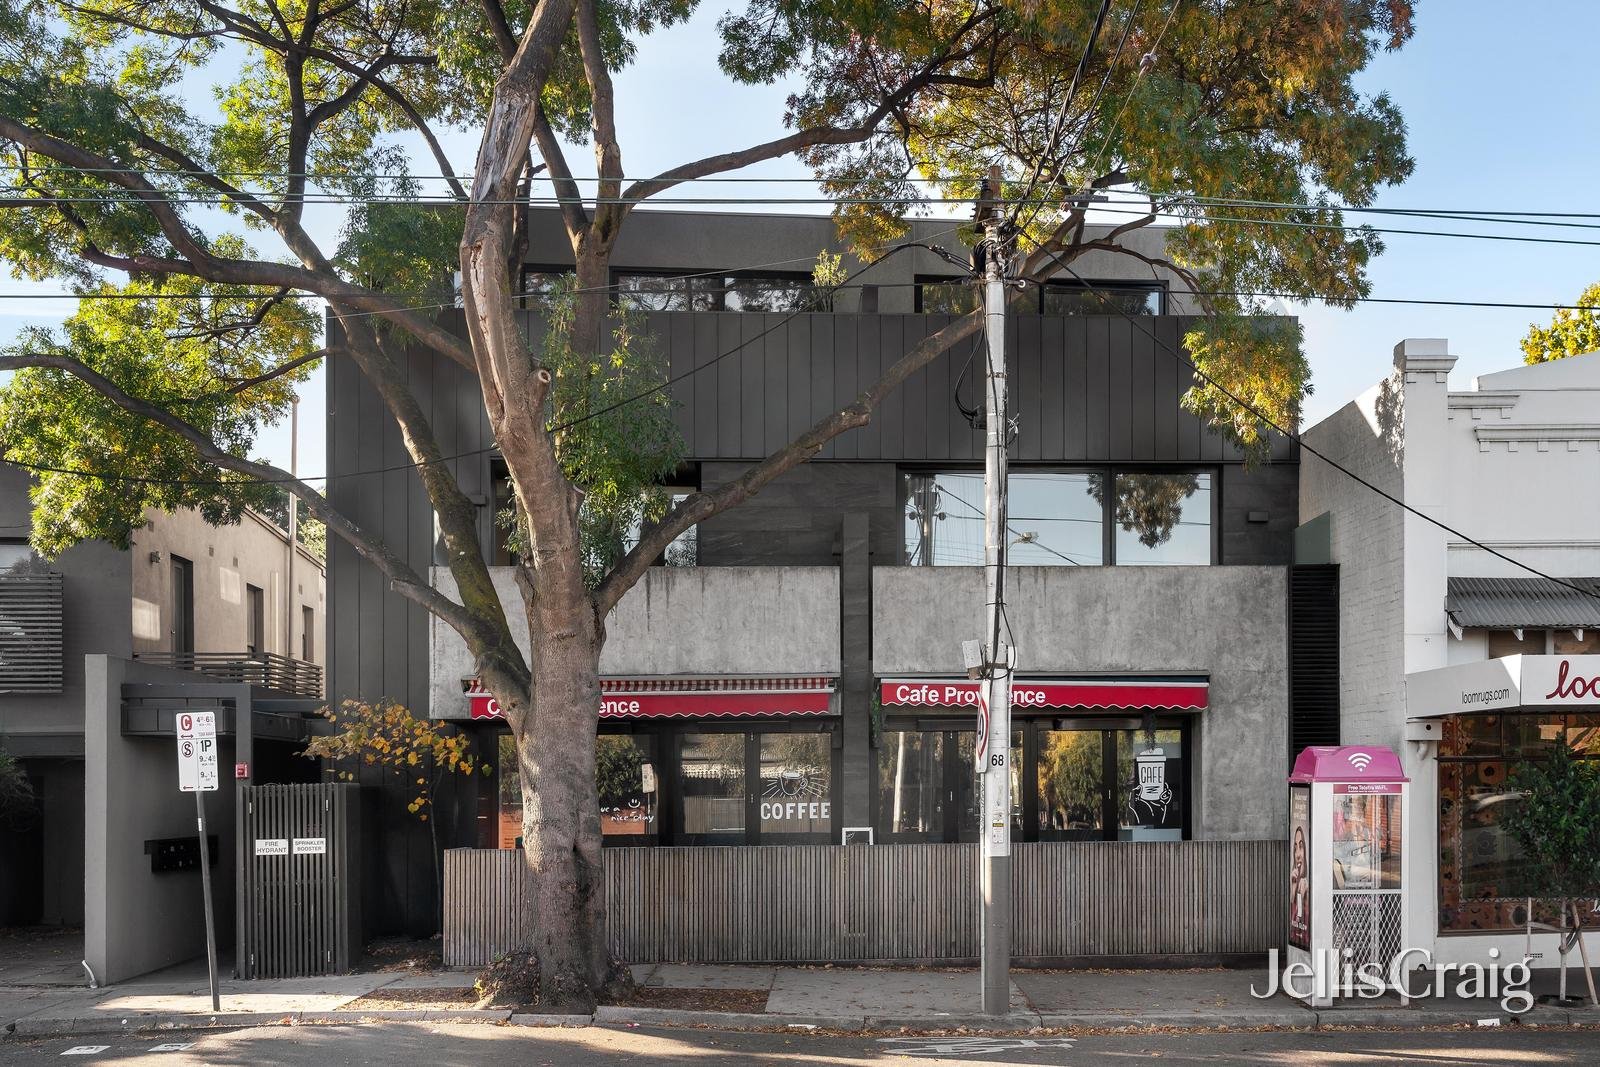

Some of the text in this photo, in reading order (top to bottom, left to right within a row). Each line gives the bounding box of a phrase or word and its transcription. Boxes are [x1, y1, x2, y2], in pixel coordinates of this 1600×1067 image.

[896, 685, 939, 703] Cafe
[1461, 687, 1510, 704] loomrugs.com
[200, 740, 212, 752] 1P
[991, 754, 1004, 766] 68
[1141, 766, 1163, 783] CAFE
[611, 813, 629, 821] nice
[760, 802, 831, 820] COFFEE
